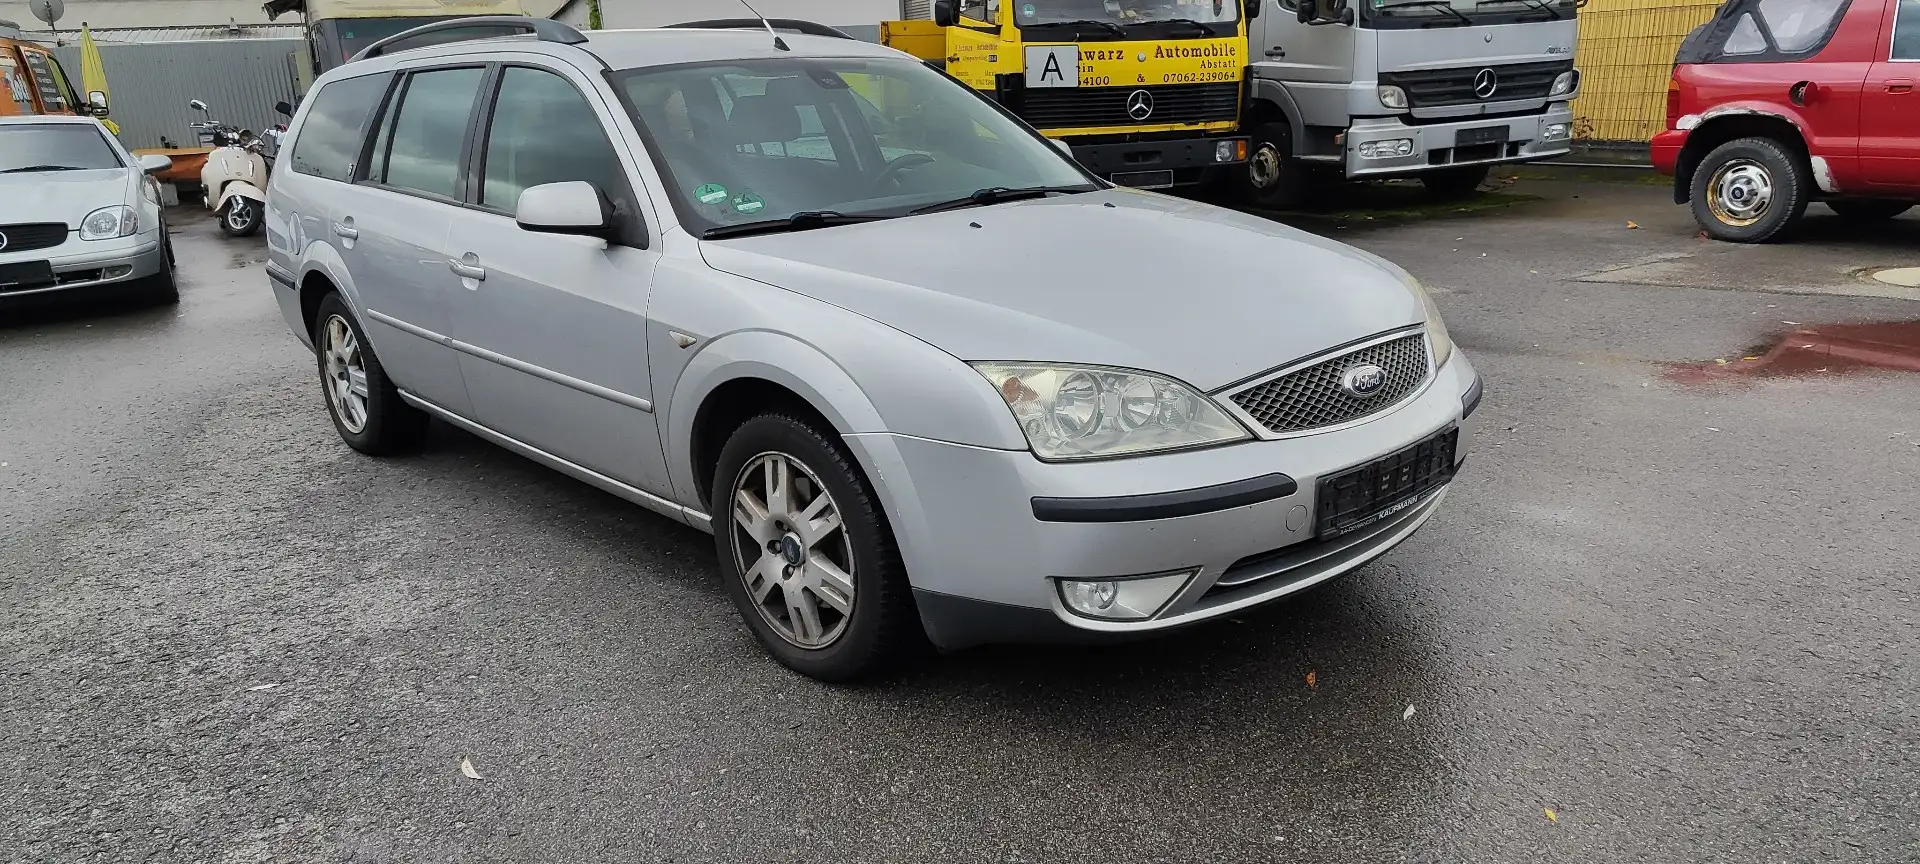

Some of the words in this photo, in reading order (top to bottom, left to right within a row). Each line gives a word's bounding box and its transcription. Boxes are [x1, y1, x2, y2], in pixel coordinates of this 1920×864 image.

[1154, 43, 1236, 58] Automobile
[1040, 51, 1064, 81] A
[1200, 60, 1236, 69] Abstatt
[1136, 73, 1146, 83] &
[1163, 71, 1236, 82] 07062-239064
[1354, 371, 1380, 390] Ford
